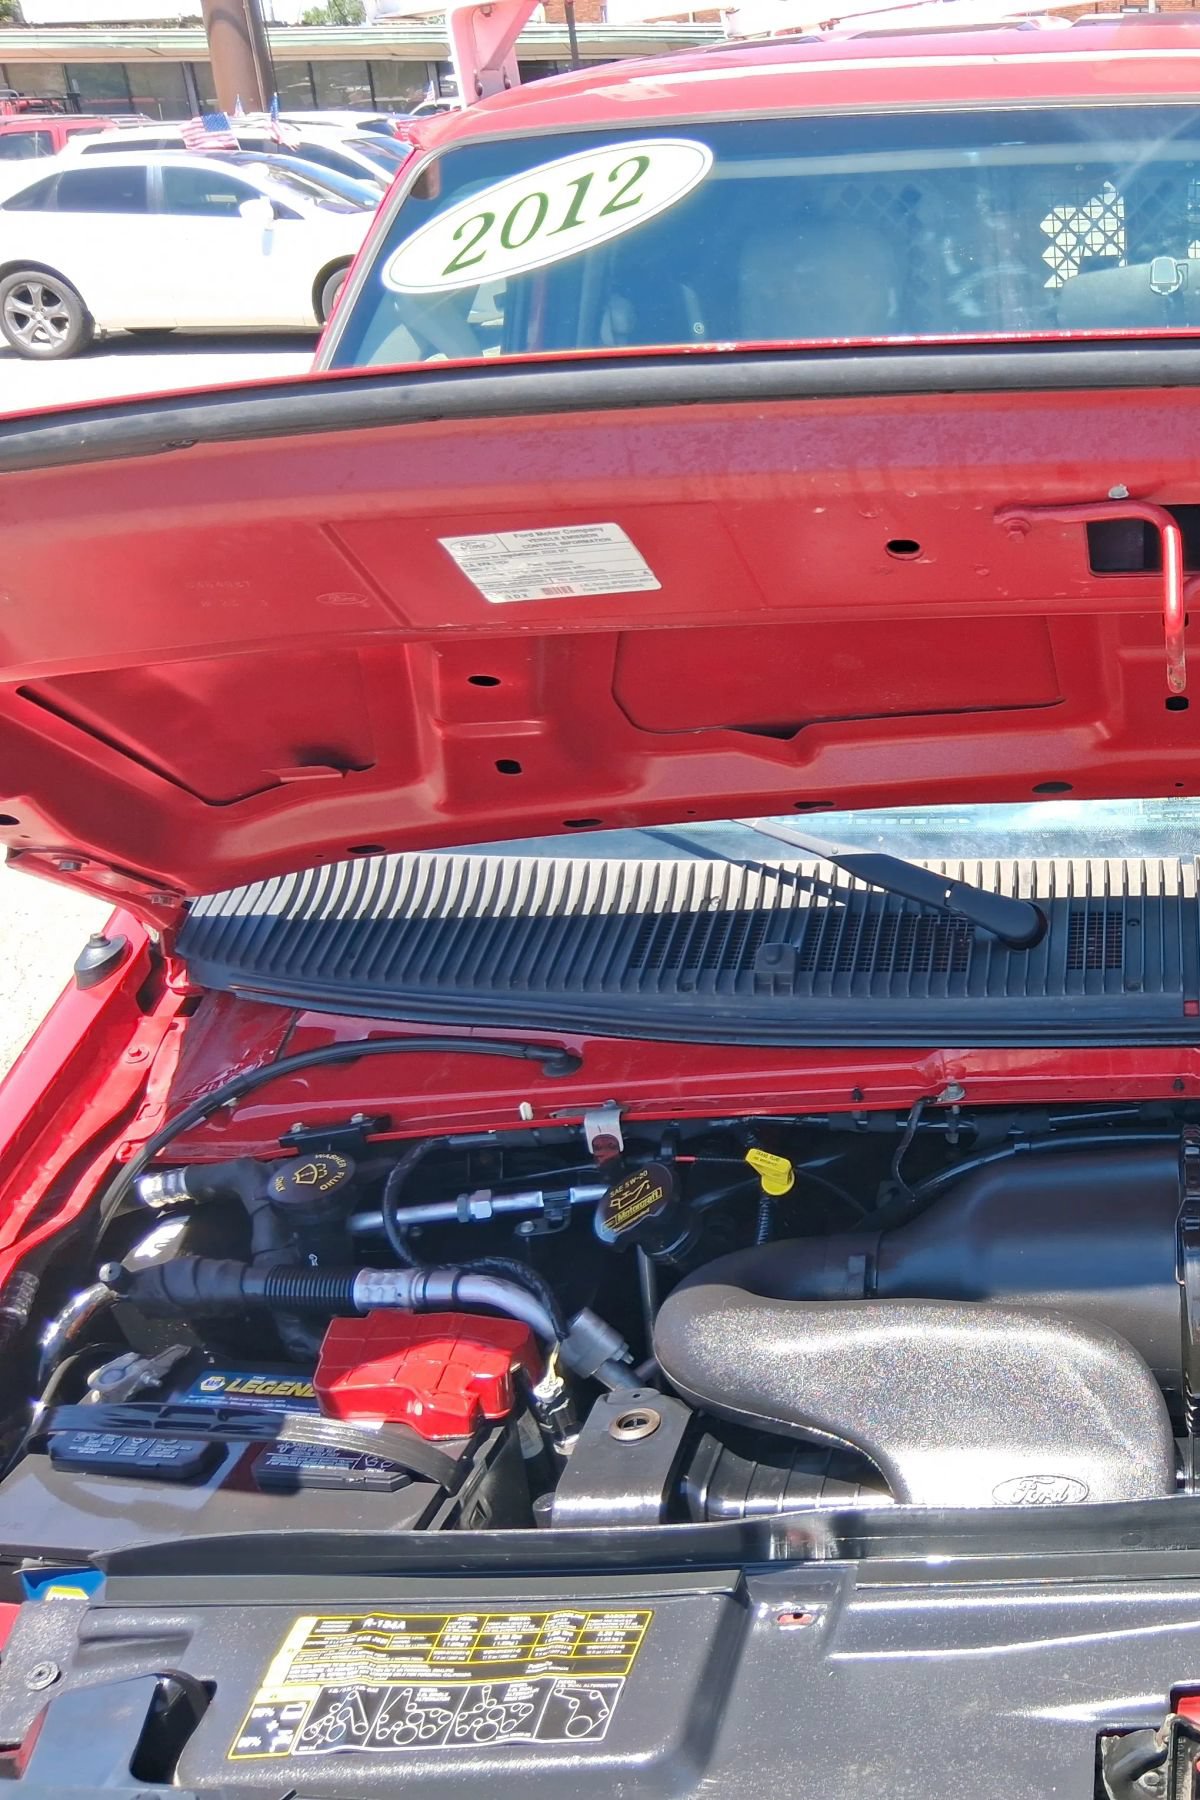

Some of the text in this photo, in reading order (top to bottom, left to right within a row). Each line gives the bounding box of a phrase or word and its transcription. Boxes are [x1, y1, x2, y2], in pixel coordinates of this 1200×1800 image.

[441, 155, 650, 277] 2012
[563, 526, 604, 535] Company
[315, 1154, 347, 1191] WASHER FLUID
[610, 1185, 624, 1198] SAE
[617, 1190, 659, 1222] Motorcraft
[1010, 1479, 1070, 1504] Ford
